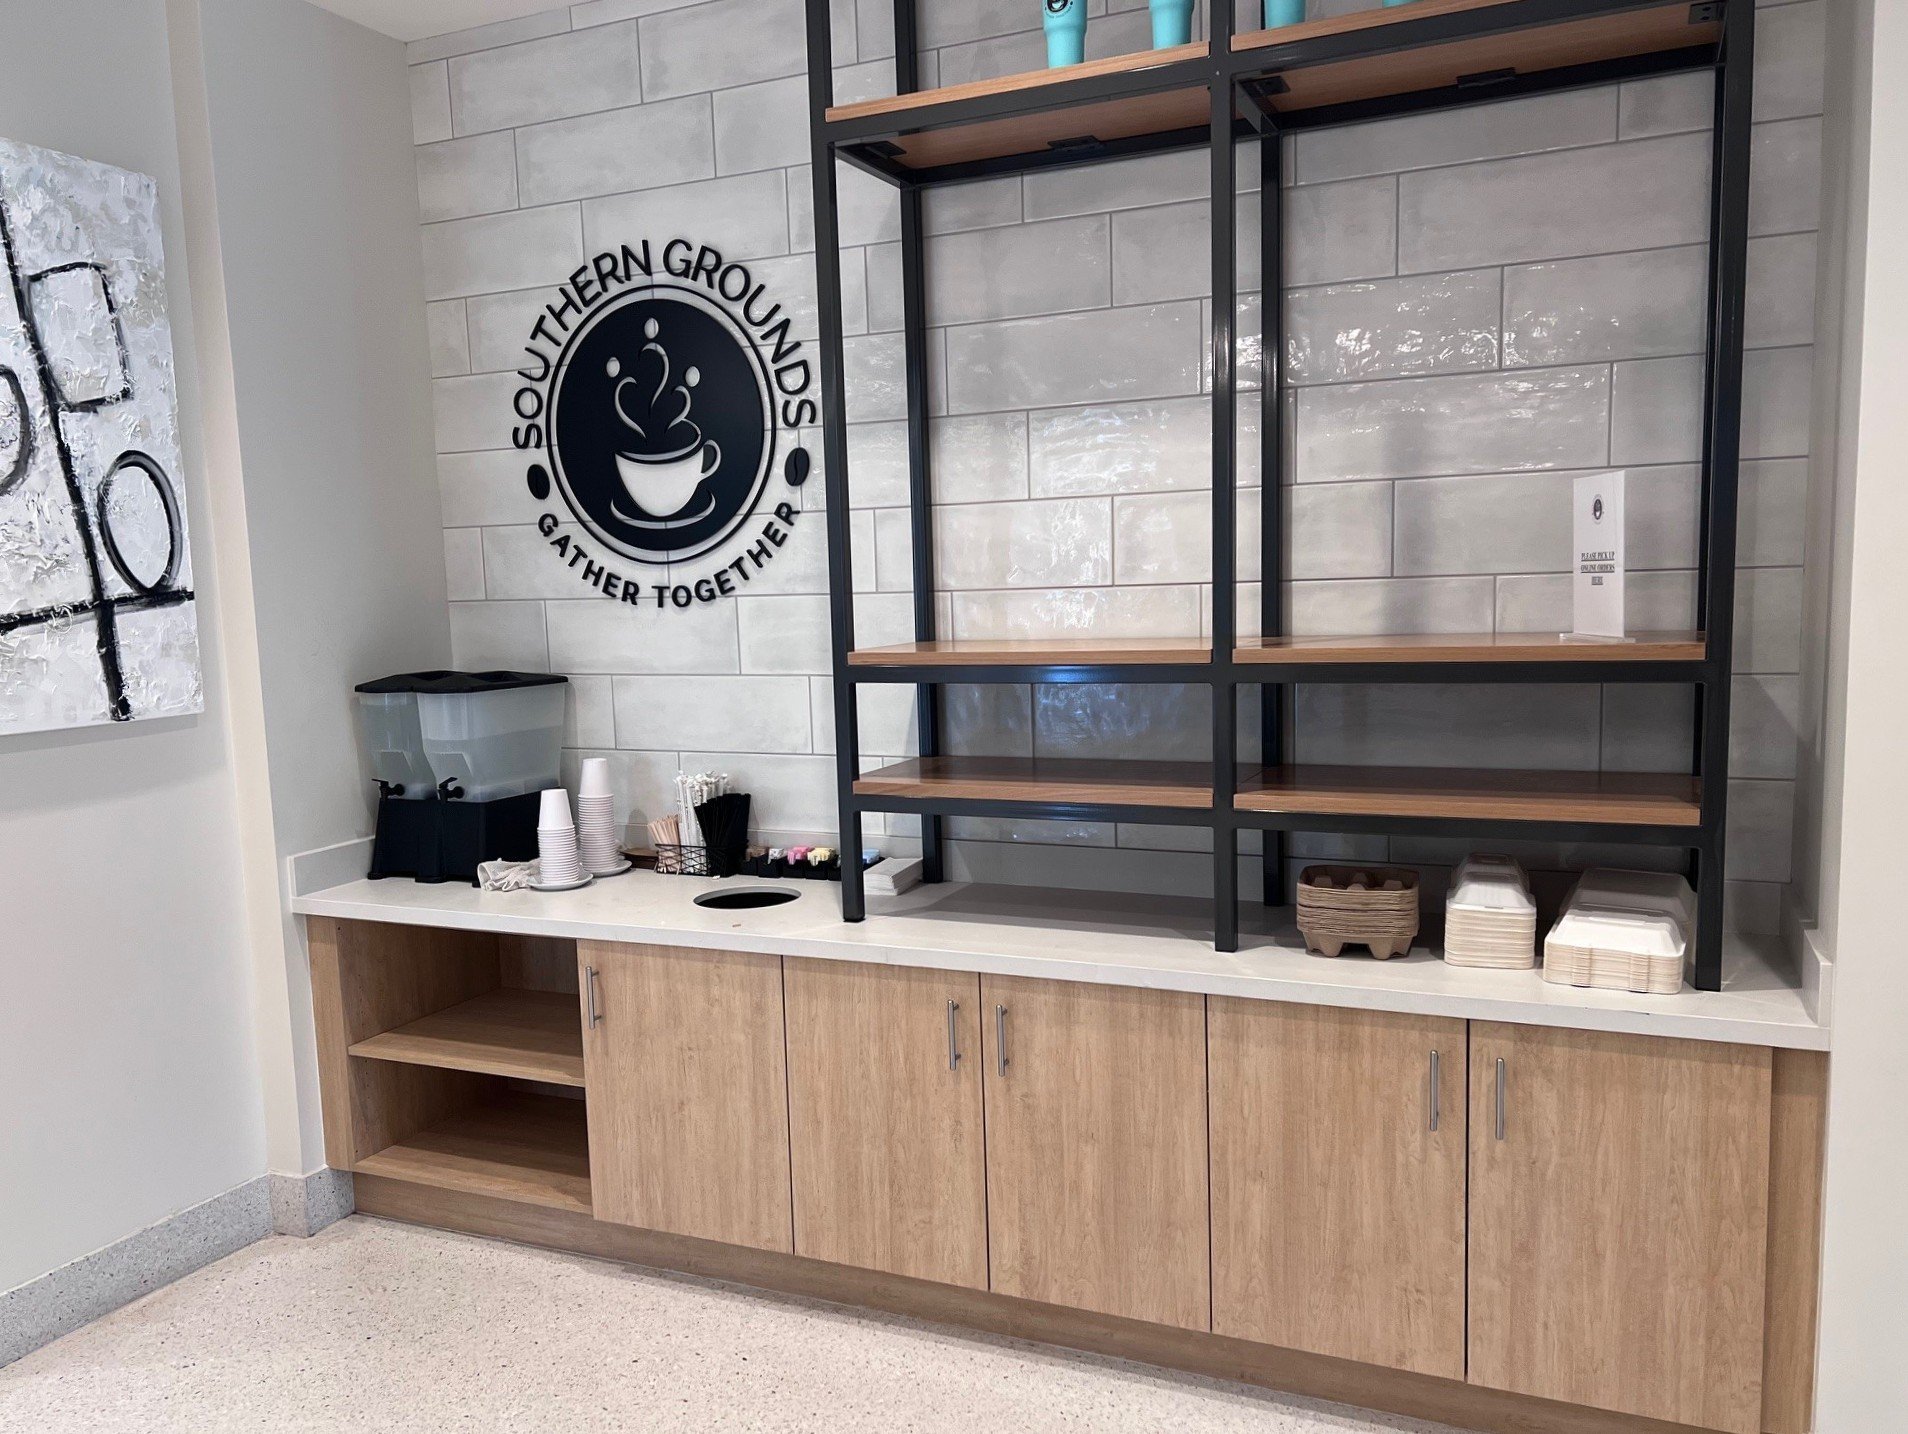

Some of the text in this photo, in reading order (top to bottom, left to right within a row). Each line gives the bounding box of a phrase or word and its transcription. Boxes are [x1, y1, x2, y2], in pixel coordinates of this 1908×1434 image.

[512, 238, 817, 449] SOUTHERN GROUNDS
[537, 501, 801, 608] GATHER TOGETHER
[1581, 552, 1597, 560] PLEASE
[1598, 552, 1608, 560] PICK
